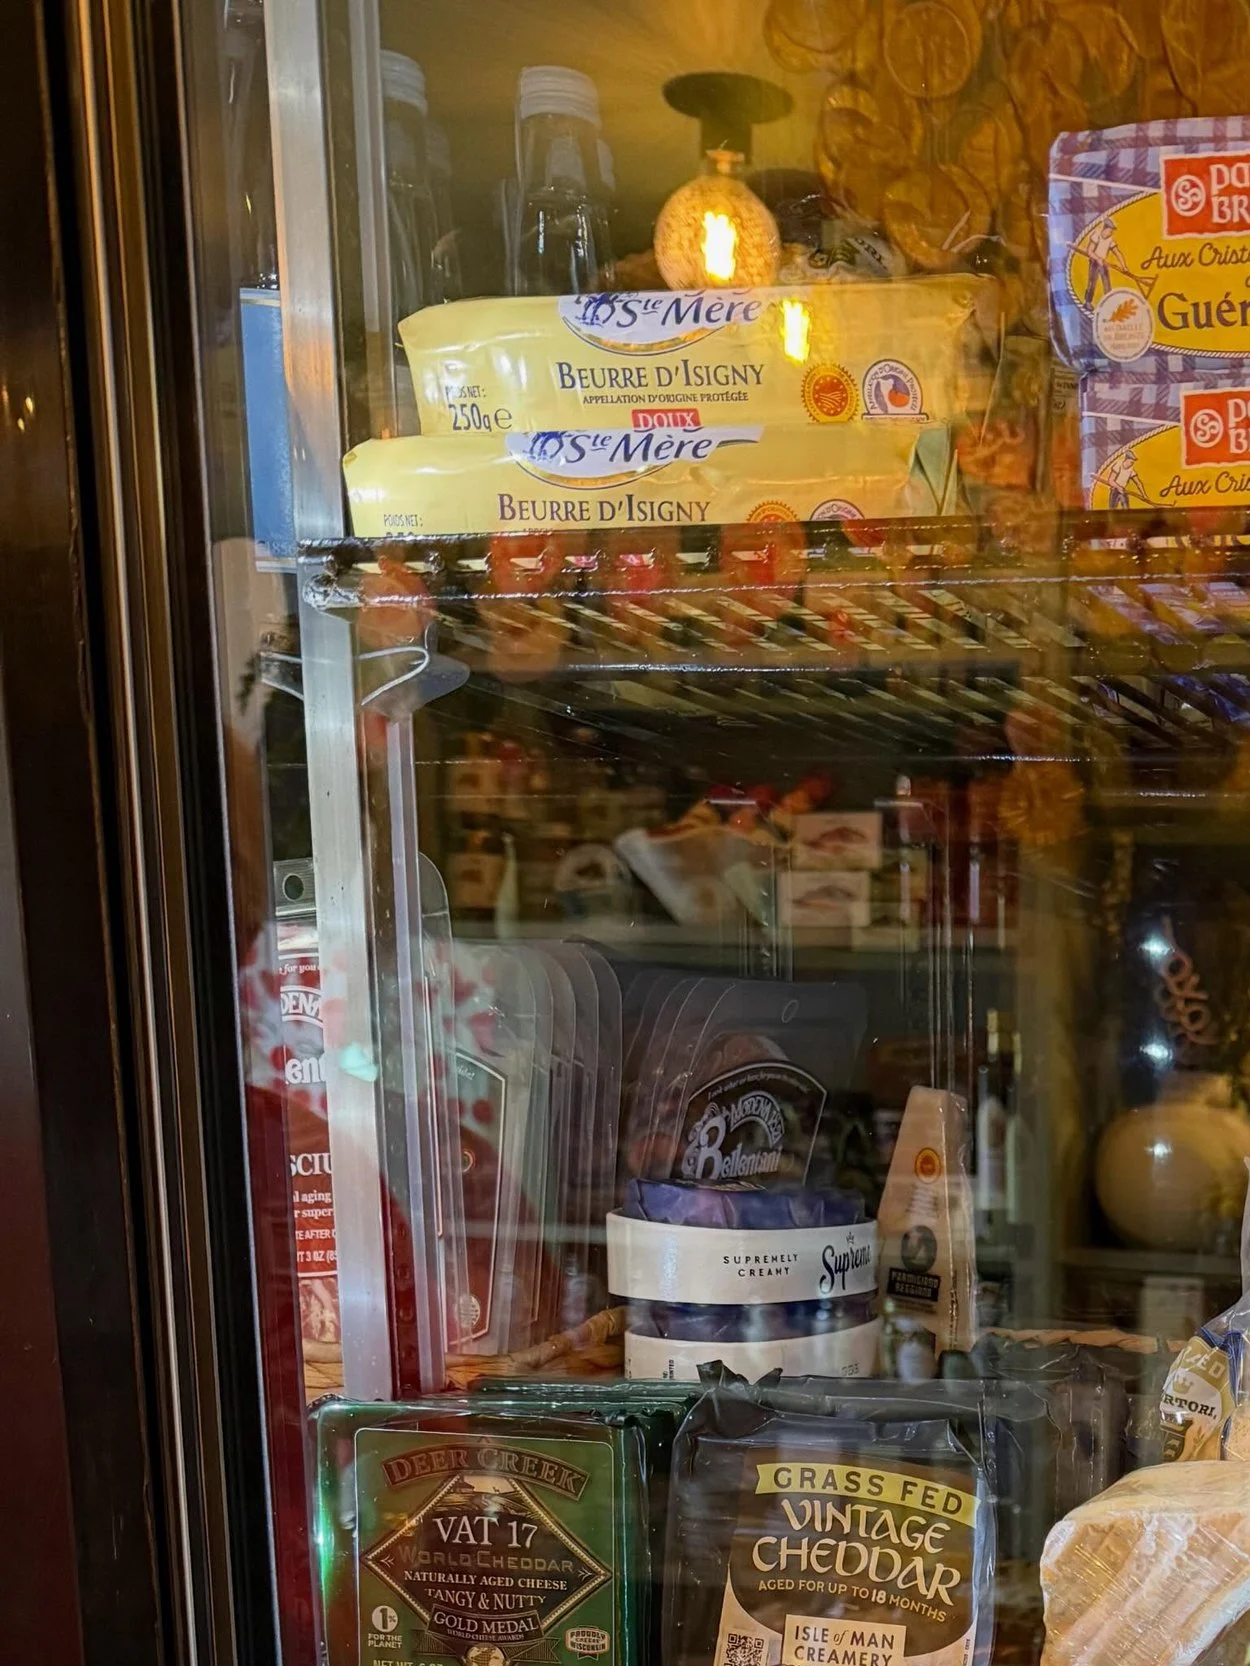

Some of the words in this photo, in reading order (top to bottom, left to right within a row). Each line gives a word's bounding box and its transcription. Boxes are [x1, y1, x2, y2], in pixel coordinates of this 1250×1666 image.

[1141, 246, 1194, 270] Aux
[661, 296, 762, 327] Mère
[557, 361, 648, 390] BEURRE
[583, 394, 645, 405] APPELLATION
[638, 411, 697, 429] DOUX
[497, 493, 590, 521] BEURRE
[723, 1253, 798, 1265] SUPREMELY
[738, 1267, 790, 1277] CREAMY
[389, 1447, 469, 1482] DEER
[477, 1447, 584, 1495] CREEK
[774, 1466, 885, 1497] GRASS
[900, 1480, 963, 1516] FED
[433, 1516, 501, 1546] VAT
[506, 1519, 538, 1549] 17
[781, 1498, 951, 1554] VINTAGE
[477, 1550, 575, 1573] CHEDDAR
[752, 1535, 961, 1607] CHEDDAR
[404, 1570, 478, 1586] NATURALLY
[480, 1576, 514, 1588] AGED
[518, 1578, 568, 1592] CHEESE
[424, 1587, 476, 1610] TANGY
[479, 1593, 490, 1610] &
[493, 1593, 546, 1611] NUTTY
[759, 1578, 795, 1592] AGED
[799, 1579, 824, 1593] FOR
[828, 1583, 848, 1596] UP
[852, 1586, 870, 1600] TO
[871, 1587, 887, 1604] 18
[889, 1595, 947, 1623] MONTHS
[433, 1611, 479, 1633] GOLD
[482, 1617, 539, 1635] MEDAL
[795, 1625, 829, 1643] ISLE
[832, 1629, 850, 1647] of
[851, 1630, 895, 1650] MAN
